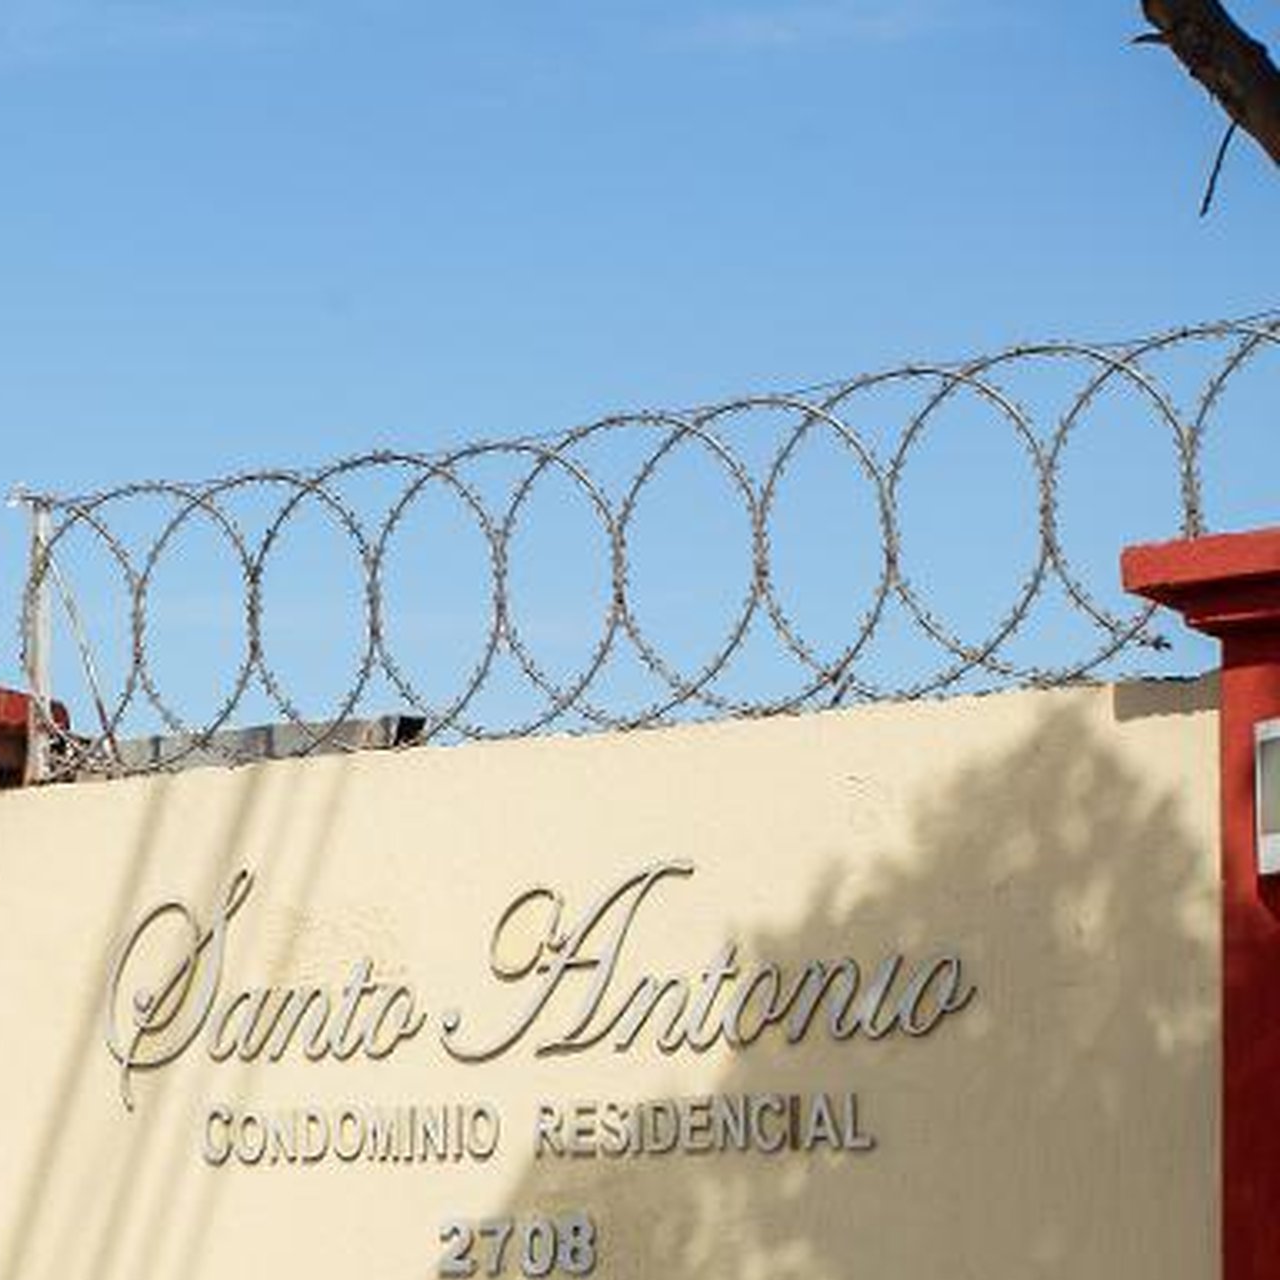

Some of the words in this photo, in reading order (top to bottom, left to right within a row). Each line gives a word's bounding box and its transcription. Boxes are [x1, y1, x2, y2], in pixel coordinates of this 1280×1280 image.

[106, 864, 429, 1112] Santo
[440, 858, 978, 1065] Antonio
[203, 1101, 501, 1168] CONDOMINIO
[535, 1092, 877, 1158] RESIDENCIAL
[438, 1211, 598, 1280] 2708
